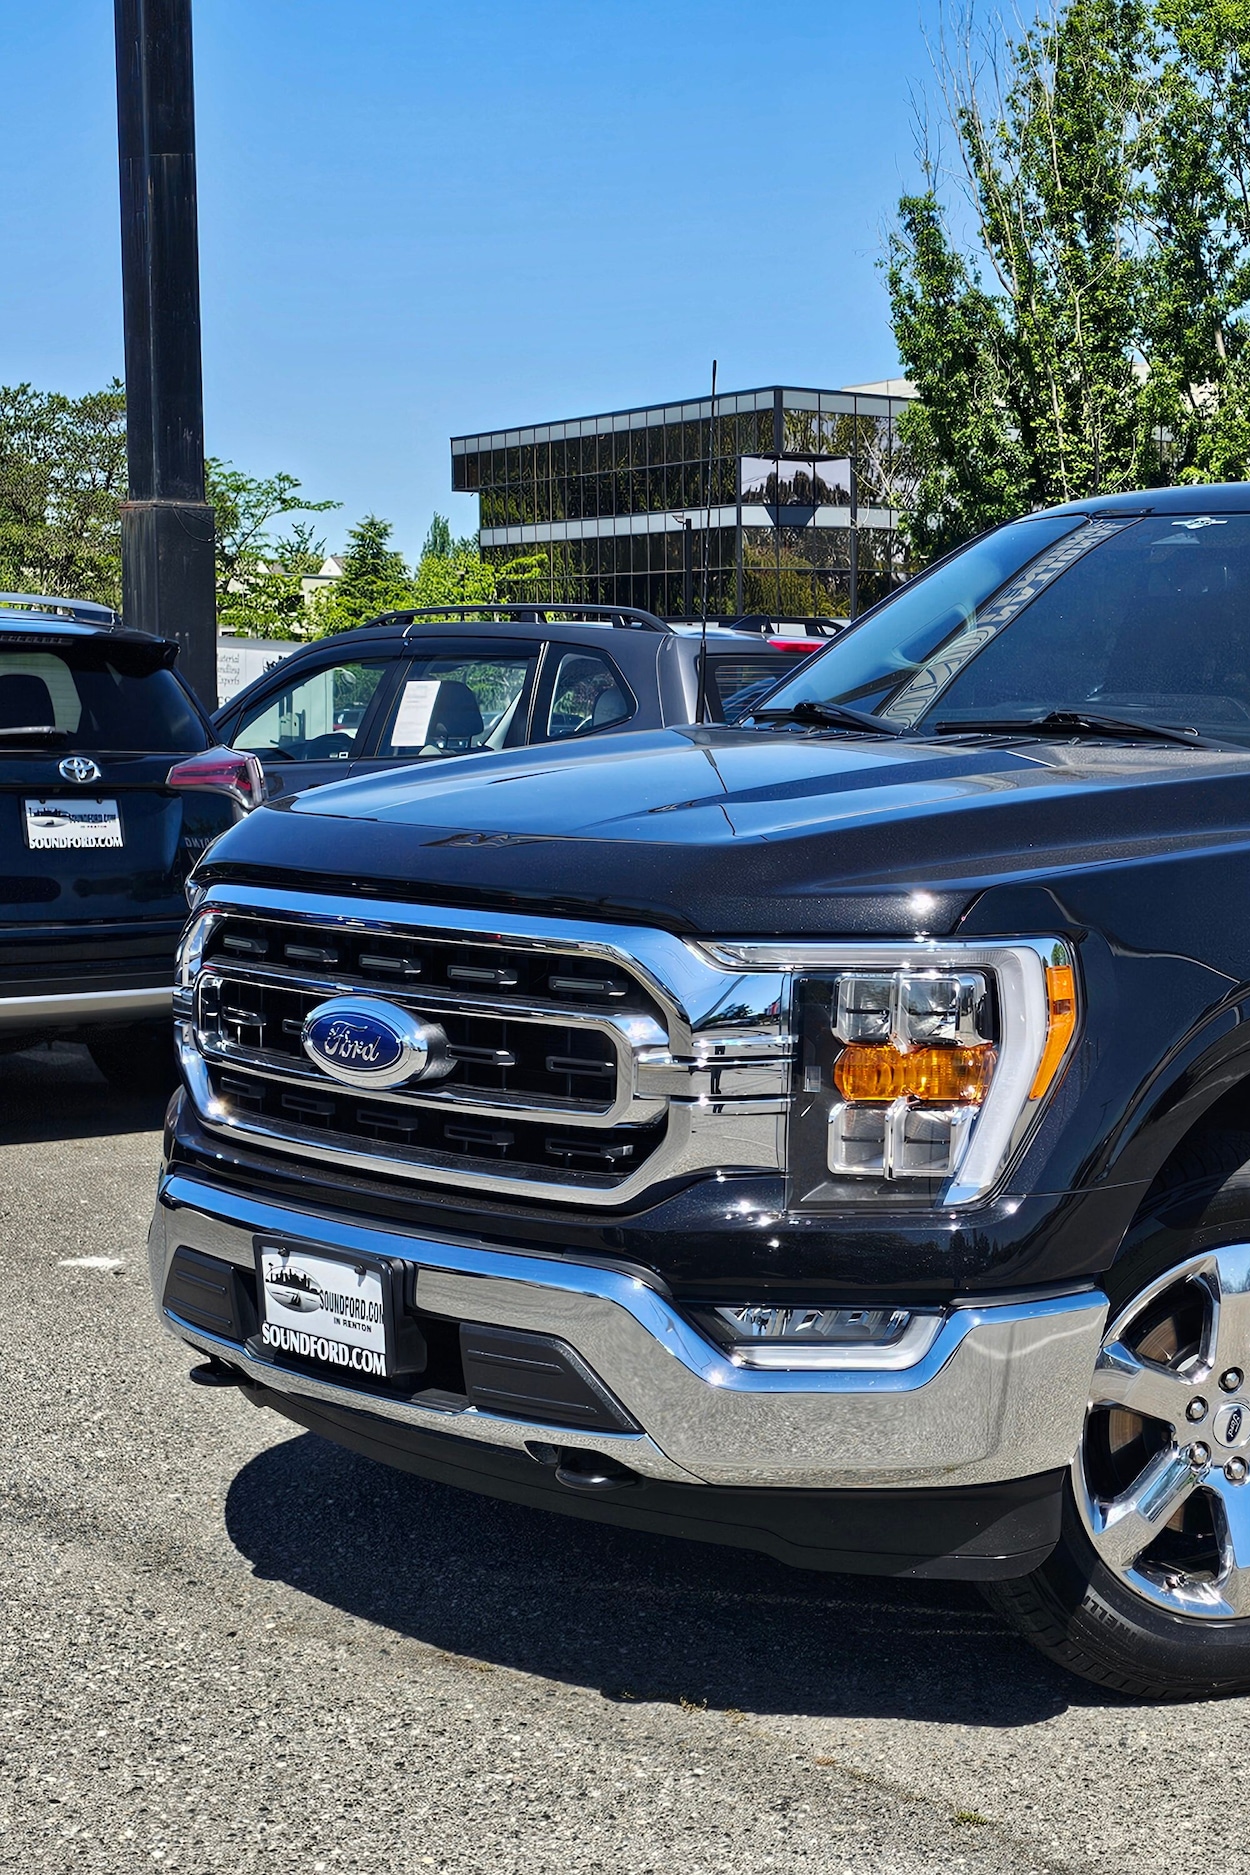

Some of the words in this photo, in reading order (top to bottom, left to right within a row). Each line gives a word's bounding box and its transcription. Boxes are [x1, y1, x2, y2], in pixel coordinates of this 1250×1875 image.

[29, 836, 124, 850] SOUNDFORD.COM
[324, 1020, 382, 1062] Ford
[333, 1316, 341, 1326] IN
[342, 1318, 372, 1333] RENTON
[261, 1322, 387, 1377] SOUNDFORD.COM
[1227, 1413, 1240, 1438] Ford
